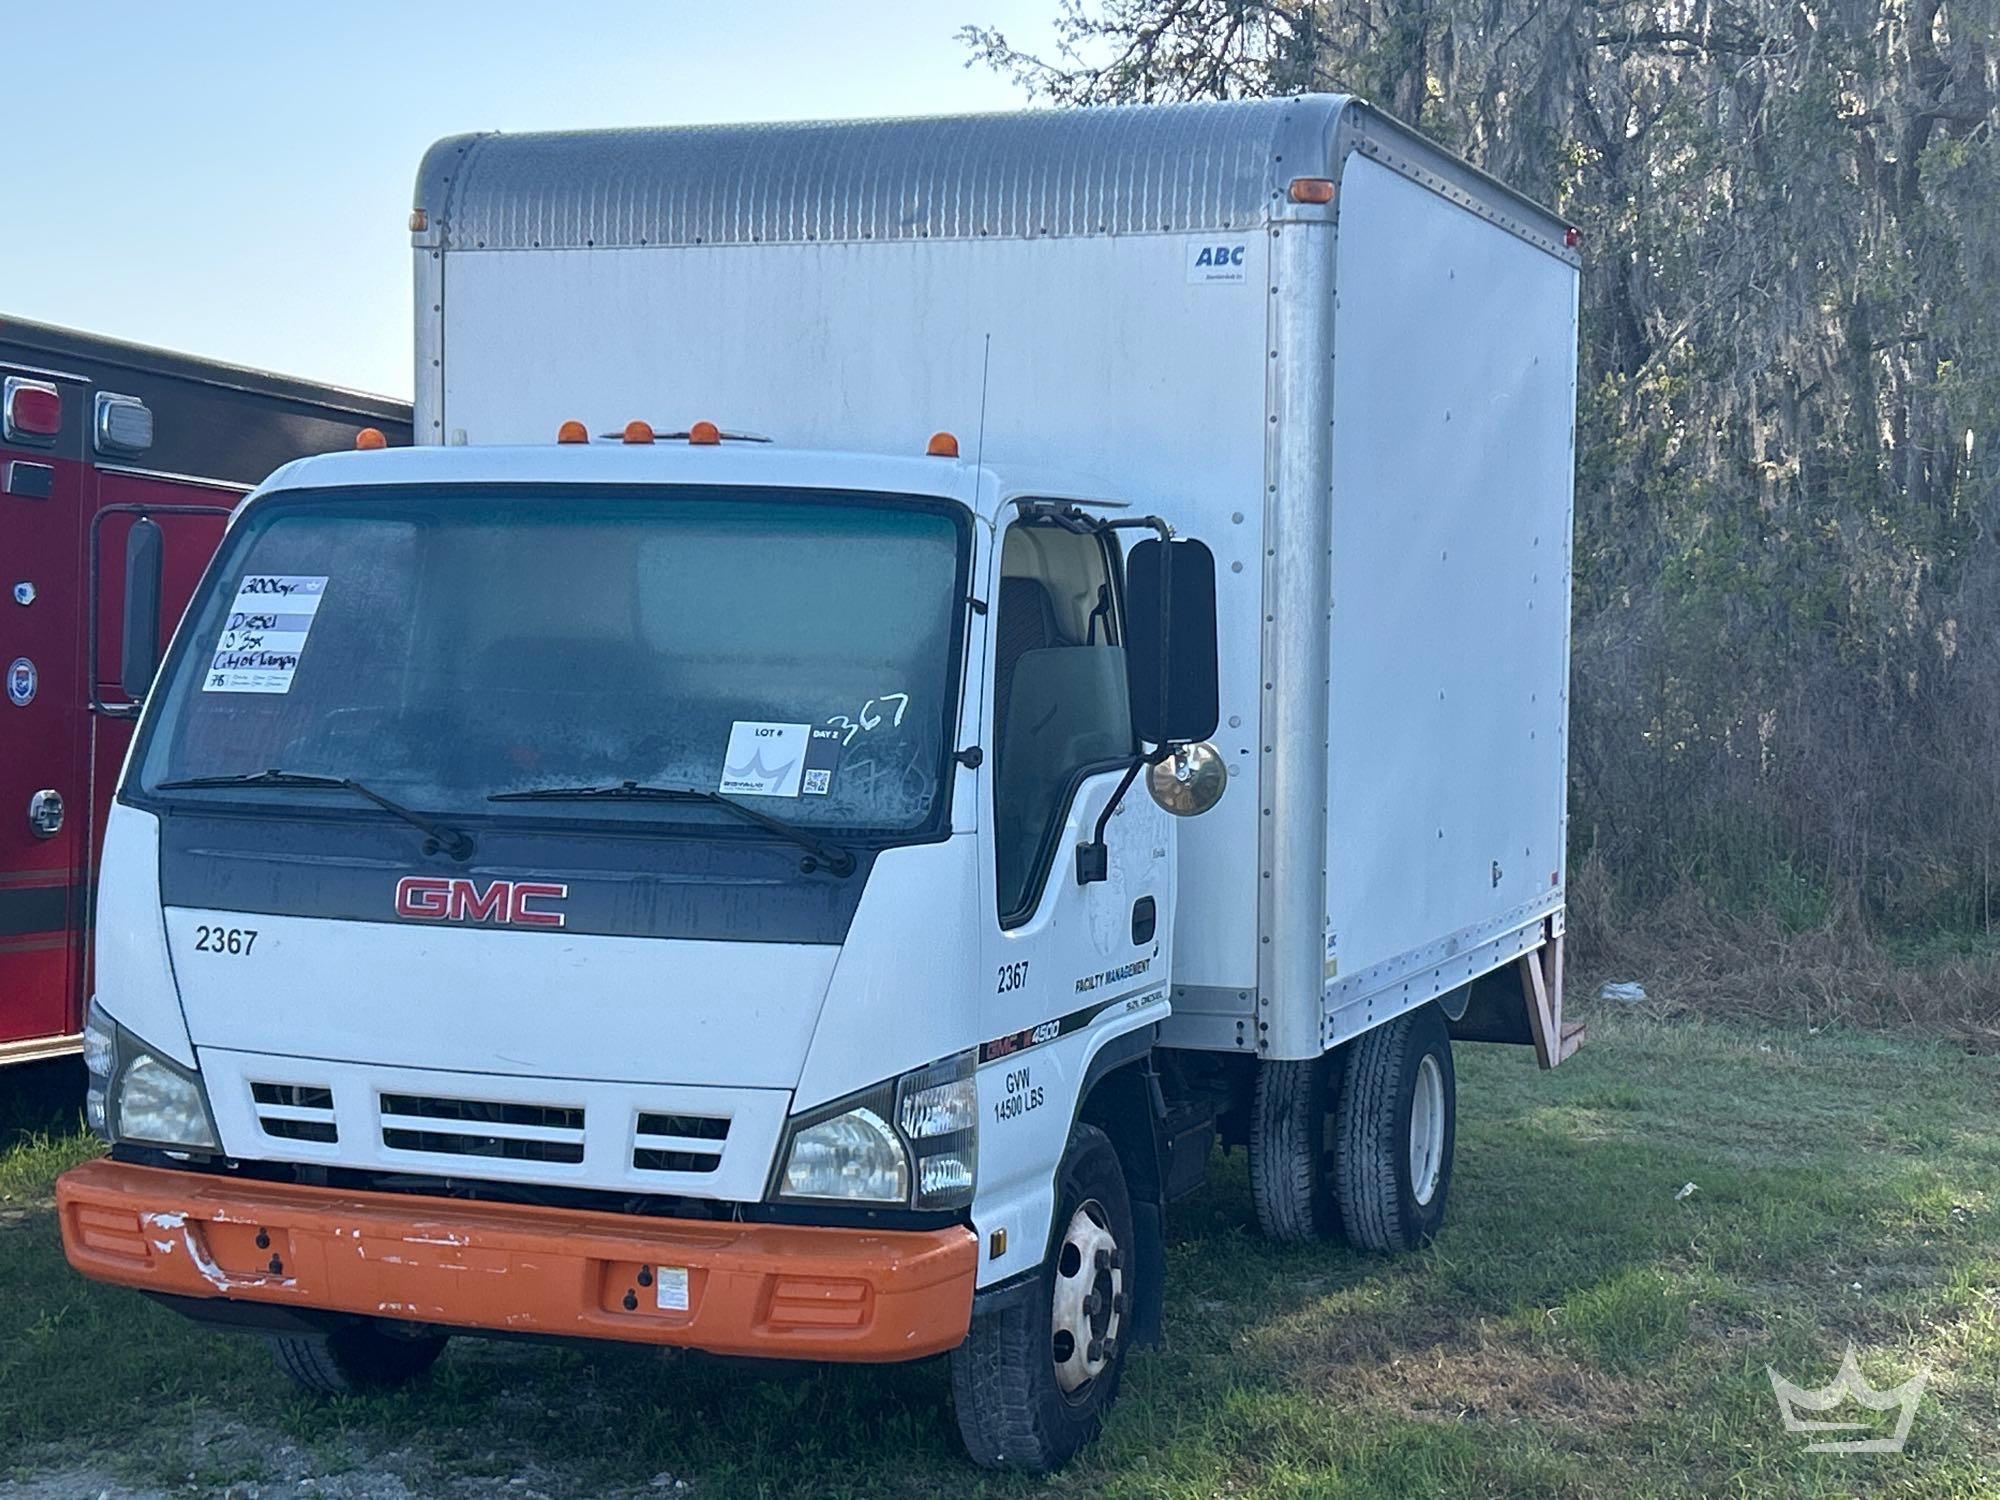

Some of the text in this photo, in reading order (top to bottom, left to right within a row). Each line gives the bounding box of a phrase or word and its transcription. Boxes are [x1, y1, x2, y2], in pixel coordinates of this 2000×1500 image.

[1195, 245, 1245, 267] ABC
[755, 728, 776, 738] LOT
[827, 692, 909, 747] 367
[813, 730, 831, 738] DAY
[395, 875, 568, 928] GMC
[194, 925, 259, 957] 2367
[997, 960, 1029, 995] 2367
[1105, 958, 1151, 986] MANAGEMENT
[987, 1035, 1018, 1059] GMC
[1006, 1067, 1030, 1094] GVW
[994, 1087, 1044, 1124] 14500 LBS
